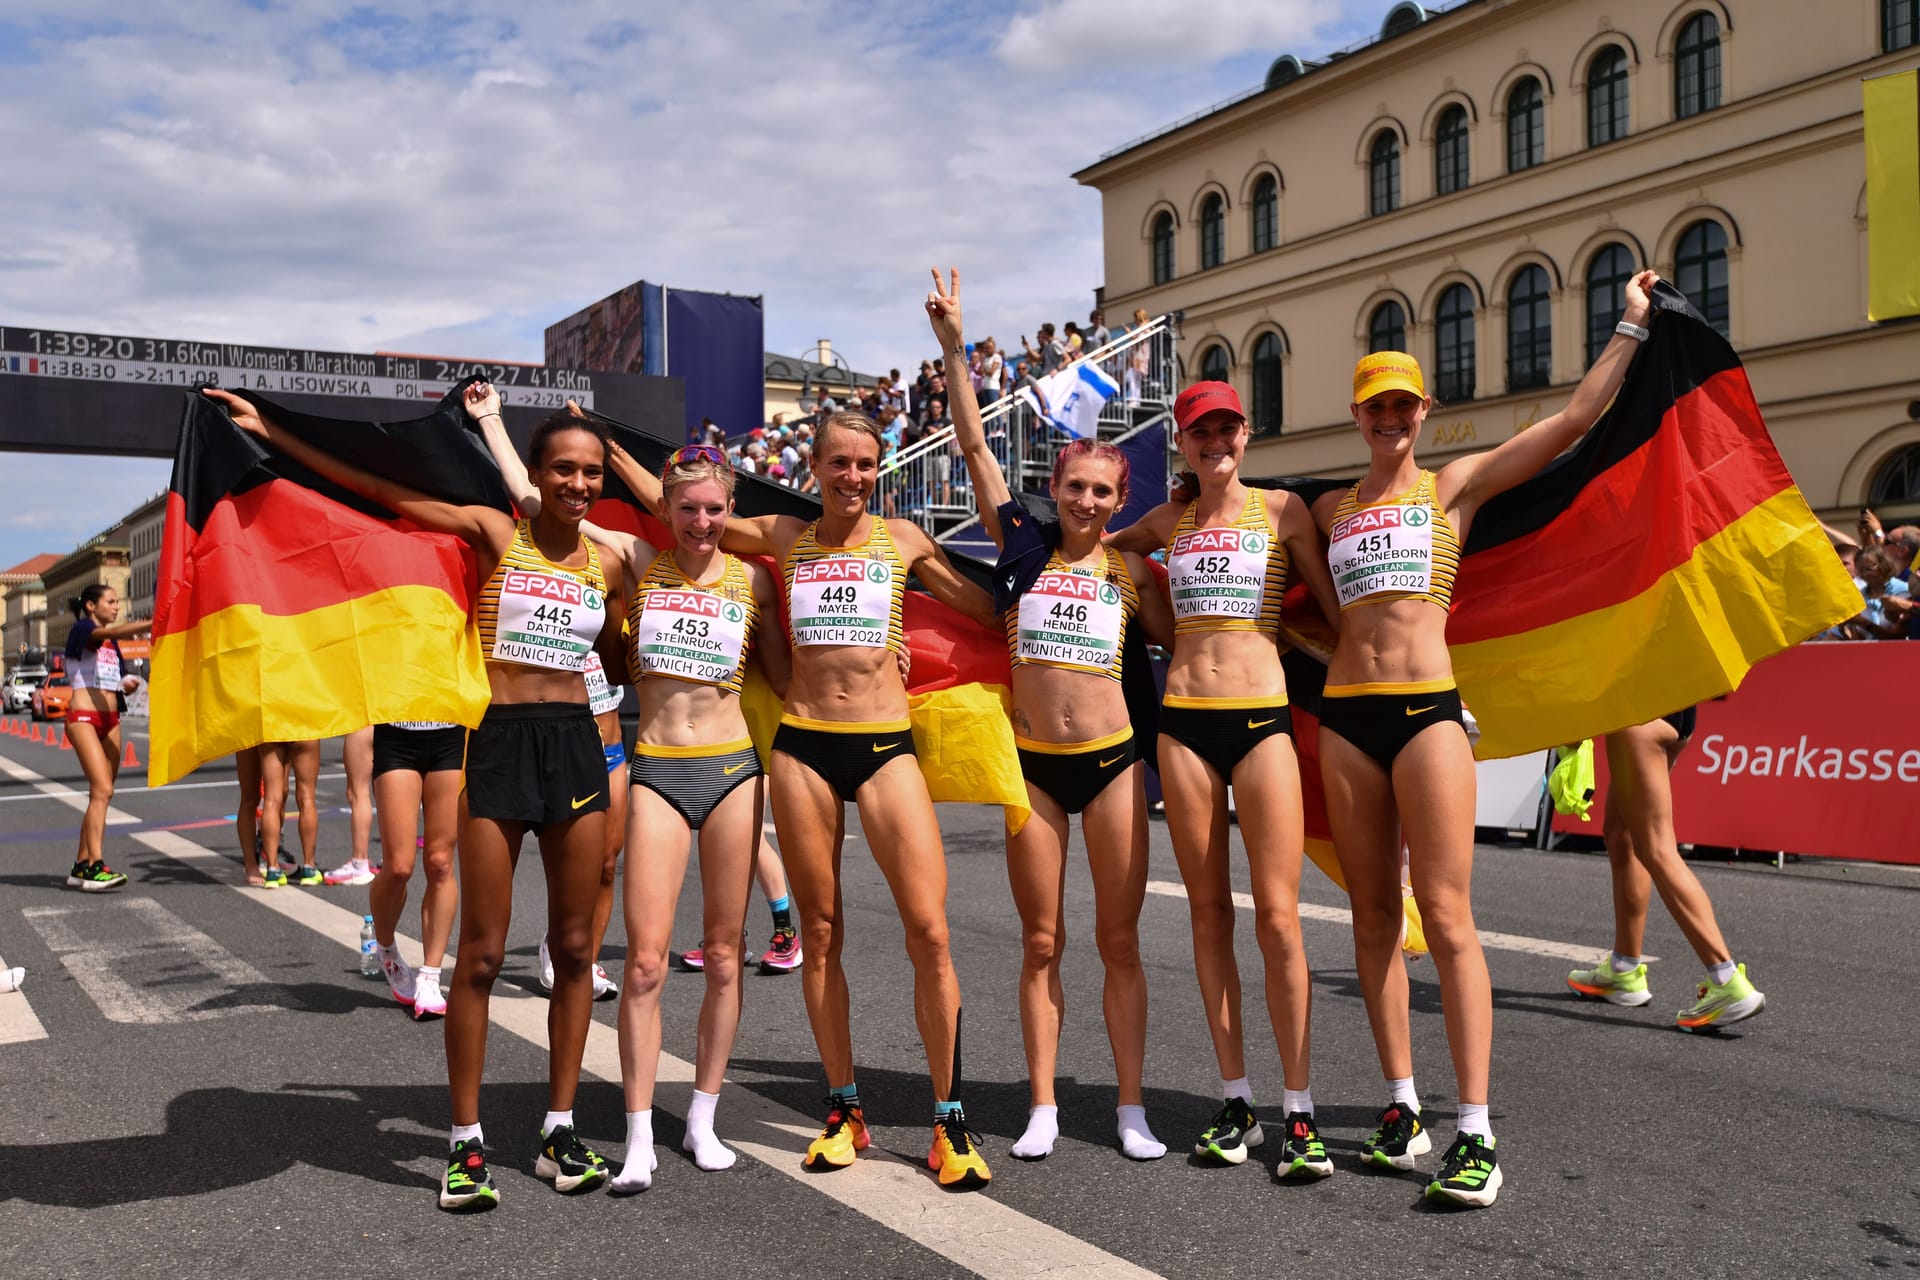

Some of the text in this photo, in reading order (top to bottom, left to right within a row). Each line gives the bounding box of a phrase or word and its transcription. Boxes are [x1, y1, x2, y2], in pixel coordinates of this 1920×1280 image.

[29, 332, 134, 360] 1:39:20
[144, 340, 219, 365] 31.6Km
[228, 345, 297, 370] Women's
[304, 352, 376, 376] Marathon
[386, 358, 420, 378] Final
[530, 369, 591, 389] 41.6Km
[40, 360, 116, 379] 1:38:30
[240, 374, 247, 387] 1
[256, 374, 273, 389] A.
[281, 376, 371, 396] LISOWSKA
[396, 383, 421, 399] POL
[1432, 419, 1477, 447] AXA
[1334, 509, 1398, 541] SPAR
[1175, 533, 1237, 553] SPAR
[1357, 533, 1391, 553] 451
[797, 562, 863, 580] SPAR
[1195, 557, 1230, 574] 452
[1332, 549, 1428, 575] D. SCHÖNEBORN
[1171, 573, 1261, 587] R. SCHÖNEBORN
[1354, 568, 1372, 579] RUN
[507, 575, 580, 603] SPAR
[820, 586, 856, 603] 449
[1342, 575, 1425, 601] MUNICH 2022
[649, 594, 719, 615] SPAR
[818, 604, 858, 614] MAYER
[1050, 602, 1088, 622] 446
[1176, 600, 1256, 614] MUNICH 2022
[534, 604, 572, 626] 445
[814, 618, 833, 626] RUN
[527, 621, 573, 637] DATTKE
[672, 617, 709, 638] 453
[797, 629, 882, 643] MUNICH 2022
[1043, 619, 1091, 634] HENDEL
[524, 635, 544, 645] RUN
[655, 632, 722, 651] STEINRUCK
[1042, 632, 1061, 642] RUN
[500, 643, 555, 663] MUNICH
[663, 647, 683, 656] RUN
[1022, 642, 1110, 664] MUNICH 2022
[642, 657, 730, 680] MUNICH 2022
[1697, 734, 1920, 785] Sparkasse
